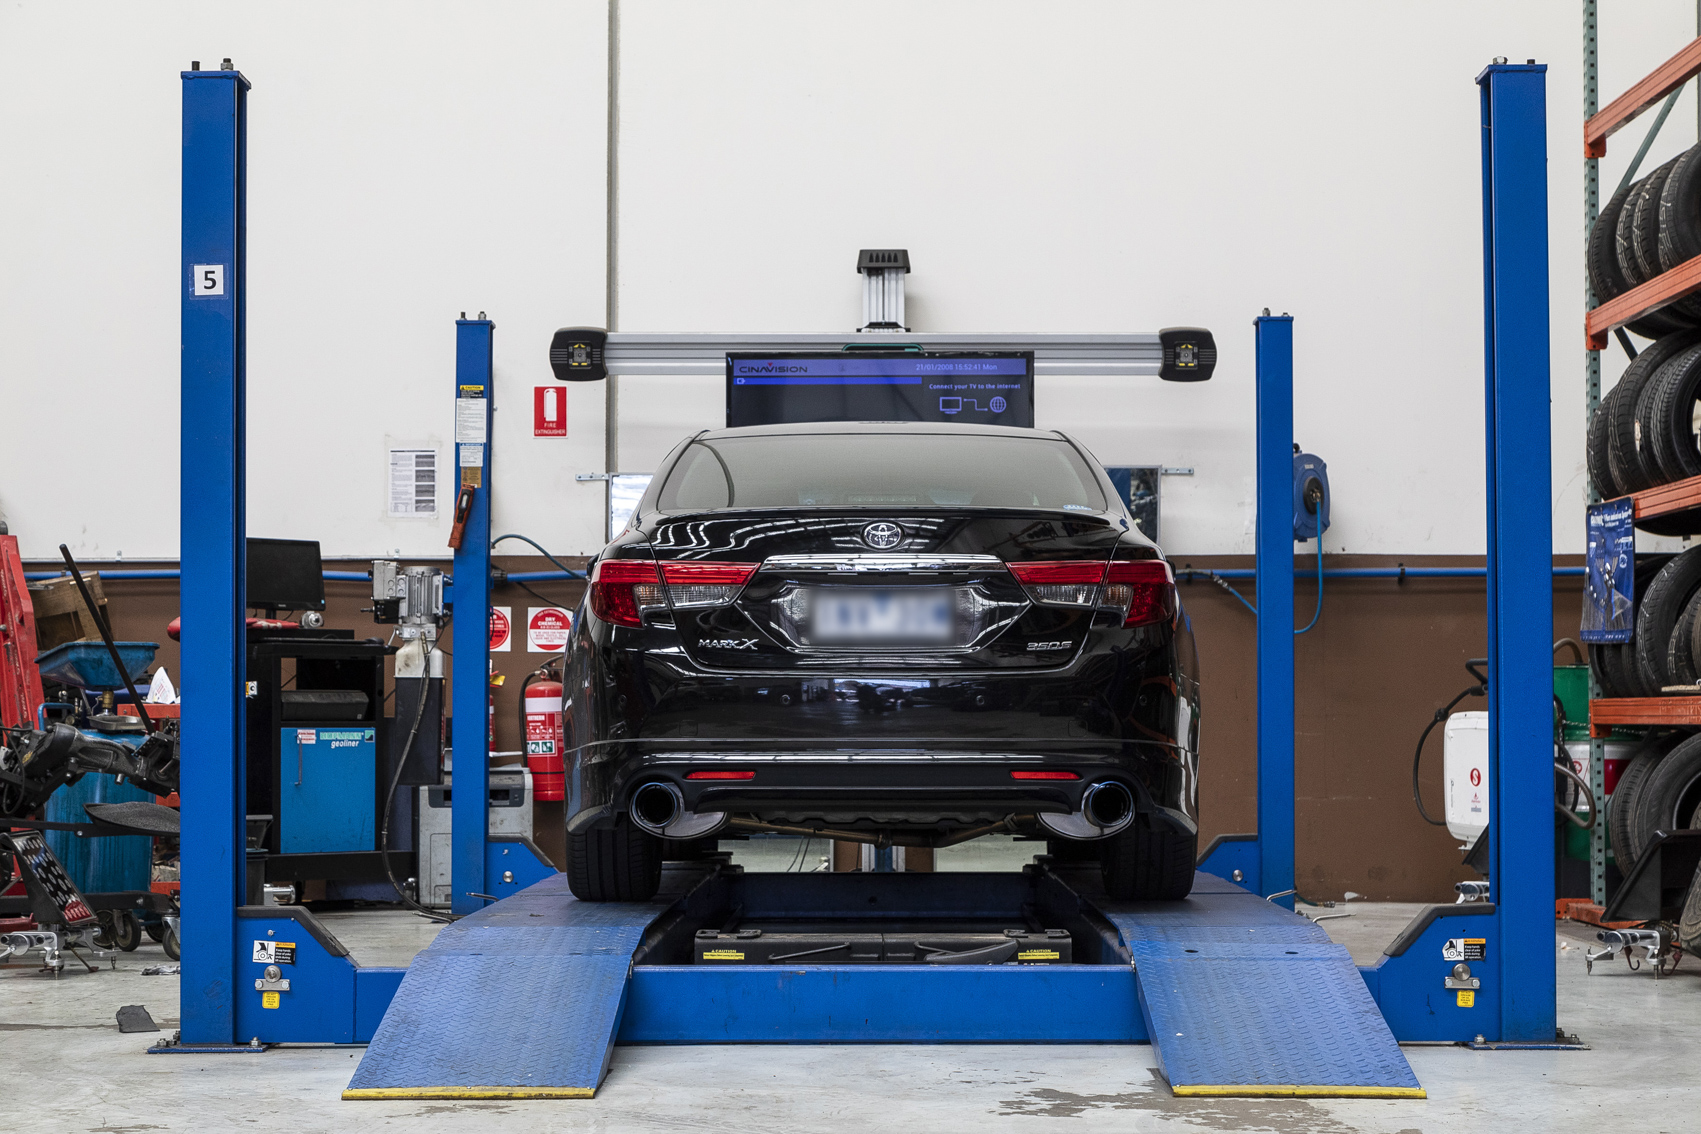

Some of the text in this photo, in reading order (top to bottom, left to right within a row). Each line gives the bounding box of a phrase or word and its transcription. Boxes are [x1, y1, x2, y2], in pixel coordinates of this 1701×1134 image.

[204, 270, 216, 290] 5
[698, 638, 760, 650] MARK X
[1026, 641, 1072, 650] 350S
[331, 740, 359, 749] geoliner
